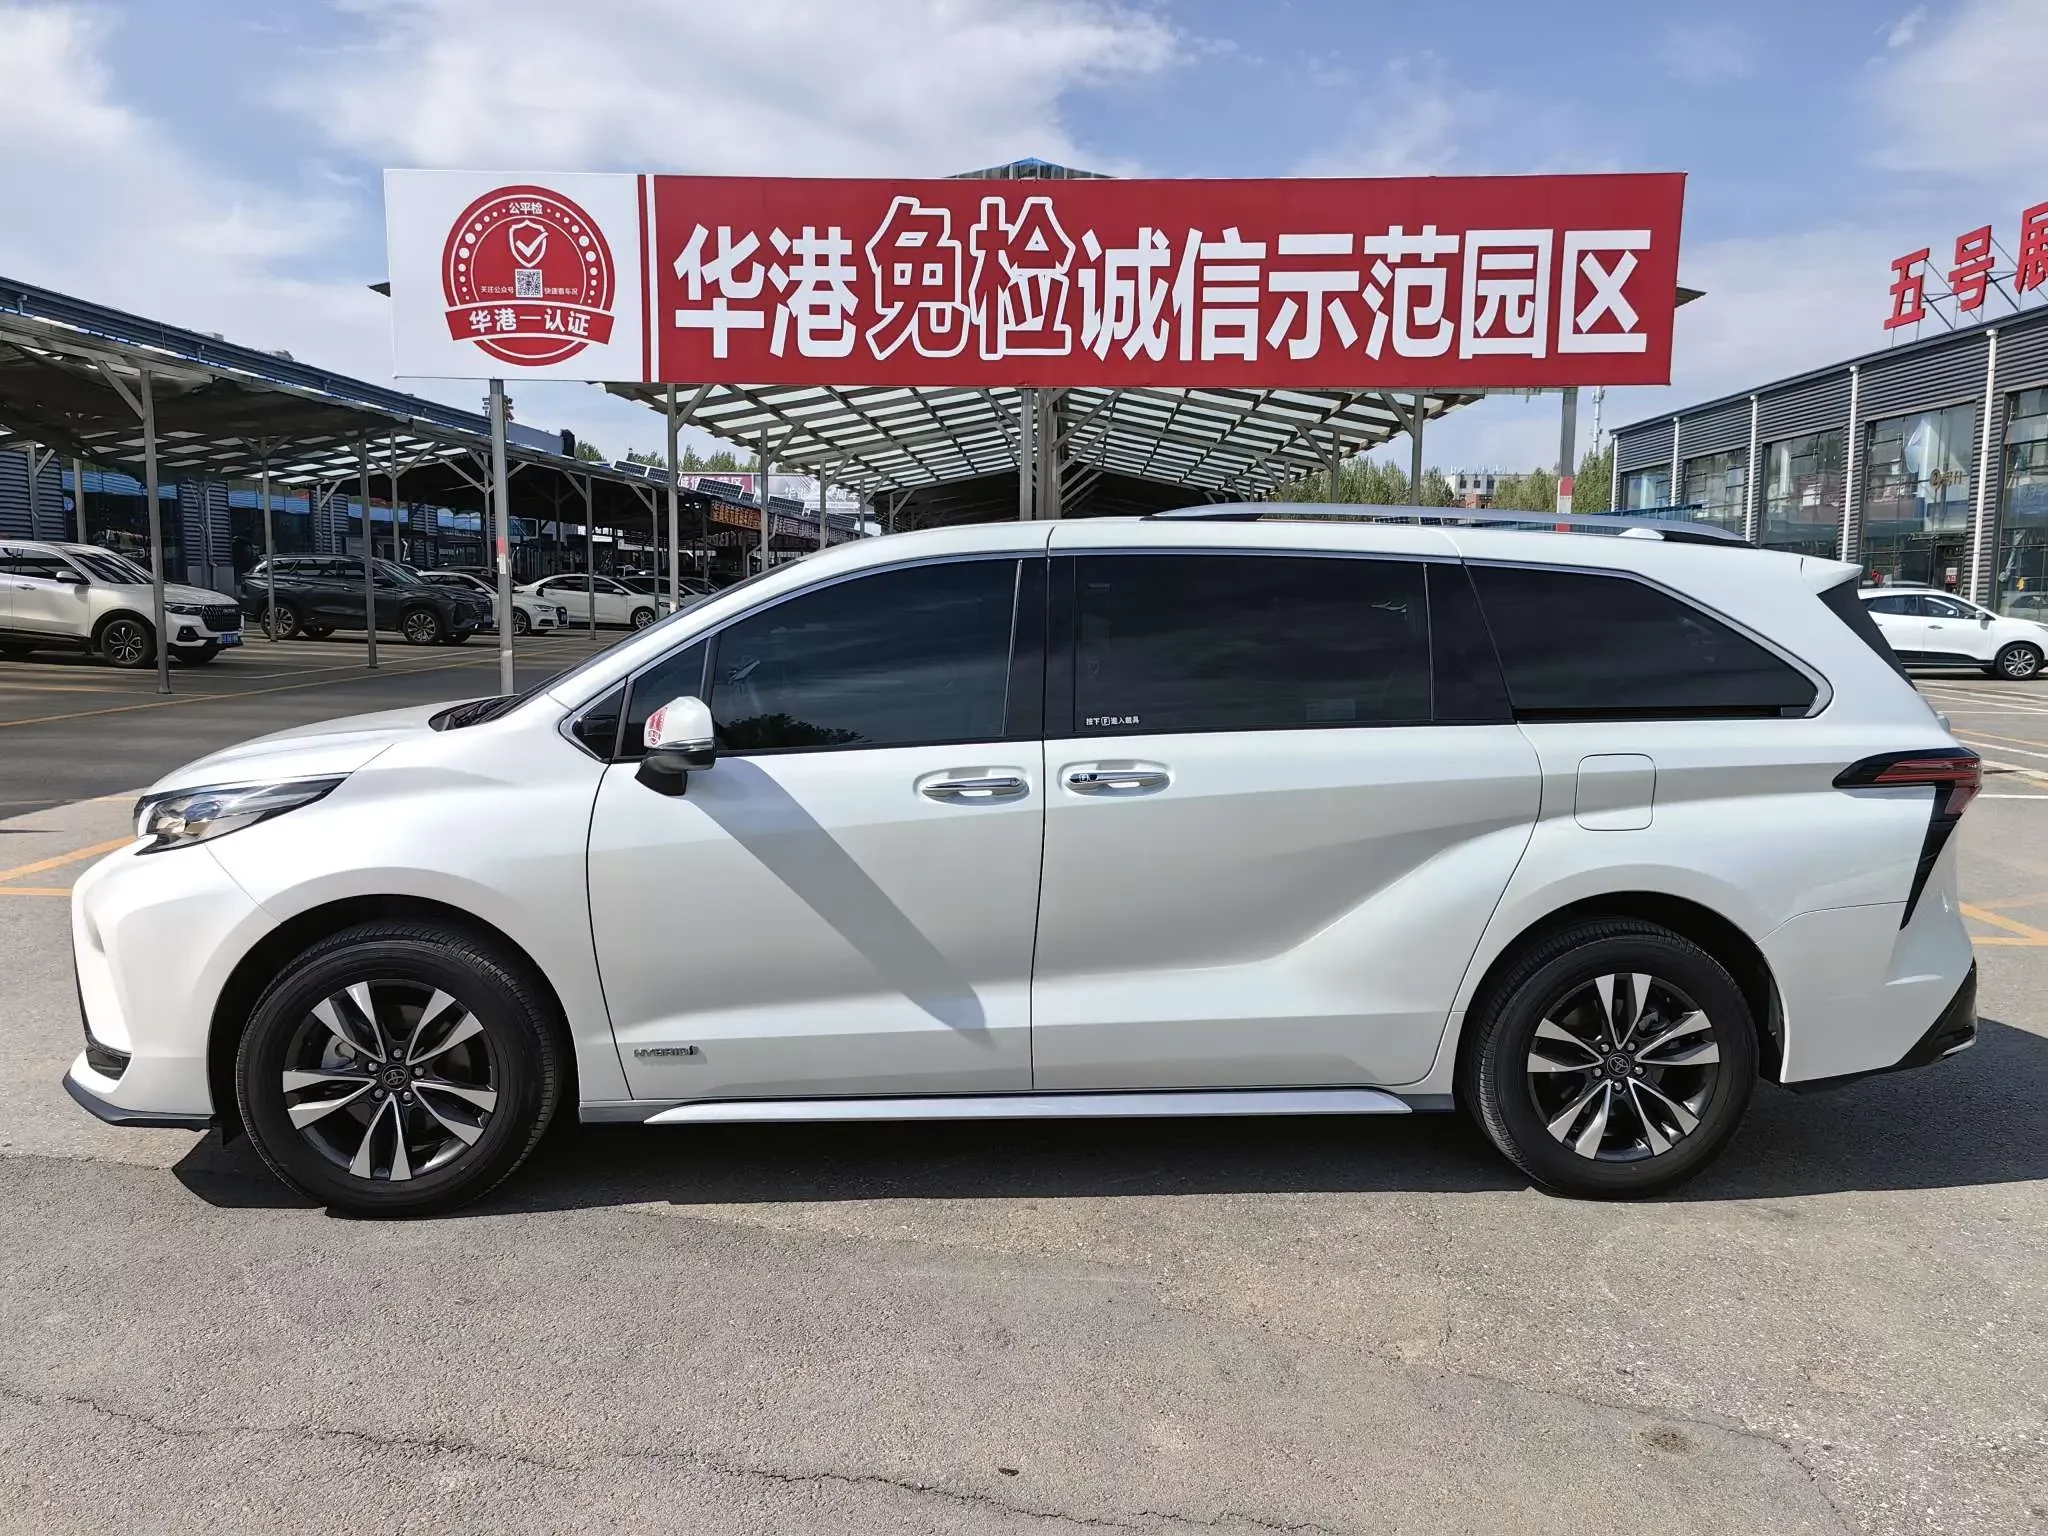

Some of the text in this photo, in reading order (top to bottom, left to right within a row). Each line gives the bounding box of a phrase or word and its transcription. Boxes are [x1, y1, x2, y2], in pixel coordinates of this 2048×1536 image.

[508, 201, 544, 215] 公平检
[673, 195, 1652, 362] 华港免检诚信示范园区
[468, 307, 592, 337] 华港一认证
